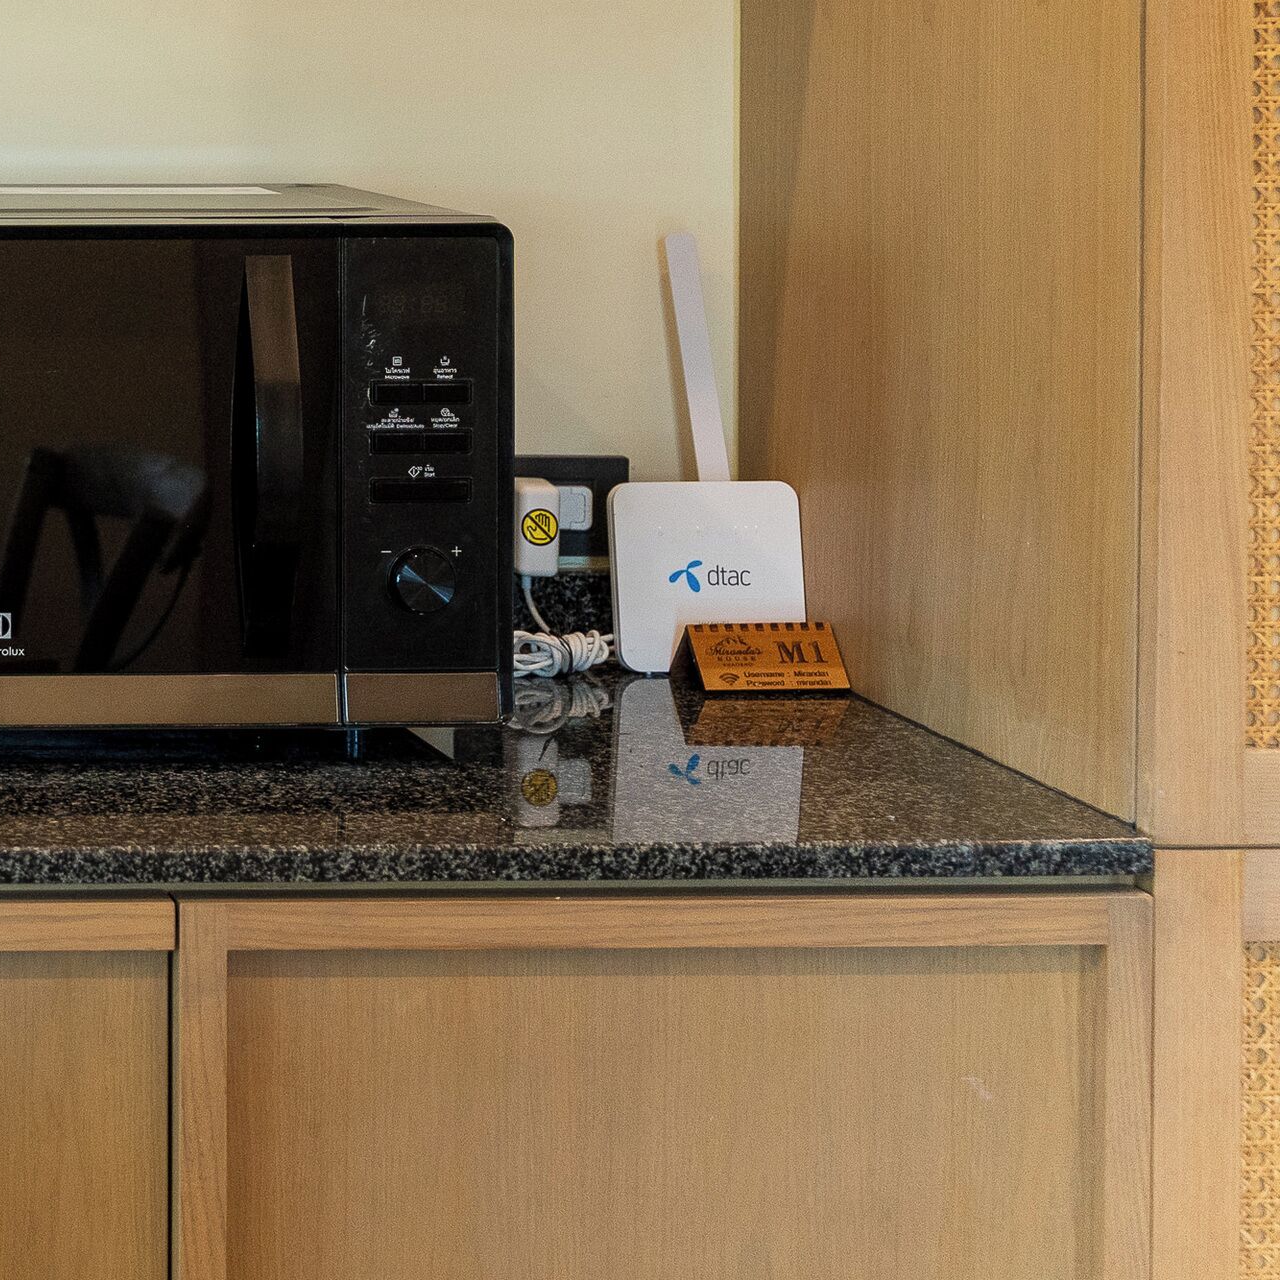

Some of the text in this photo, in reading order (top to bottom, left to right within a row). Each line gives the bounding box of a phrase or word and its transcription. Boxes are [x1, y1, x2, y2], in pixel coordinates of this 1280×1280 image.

[707, 565, 751, 587] dtac
[774, 640, 829, 664] M1
[744, 670, 785, 678] Username
